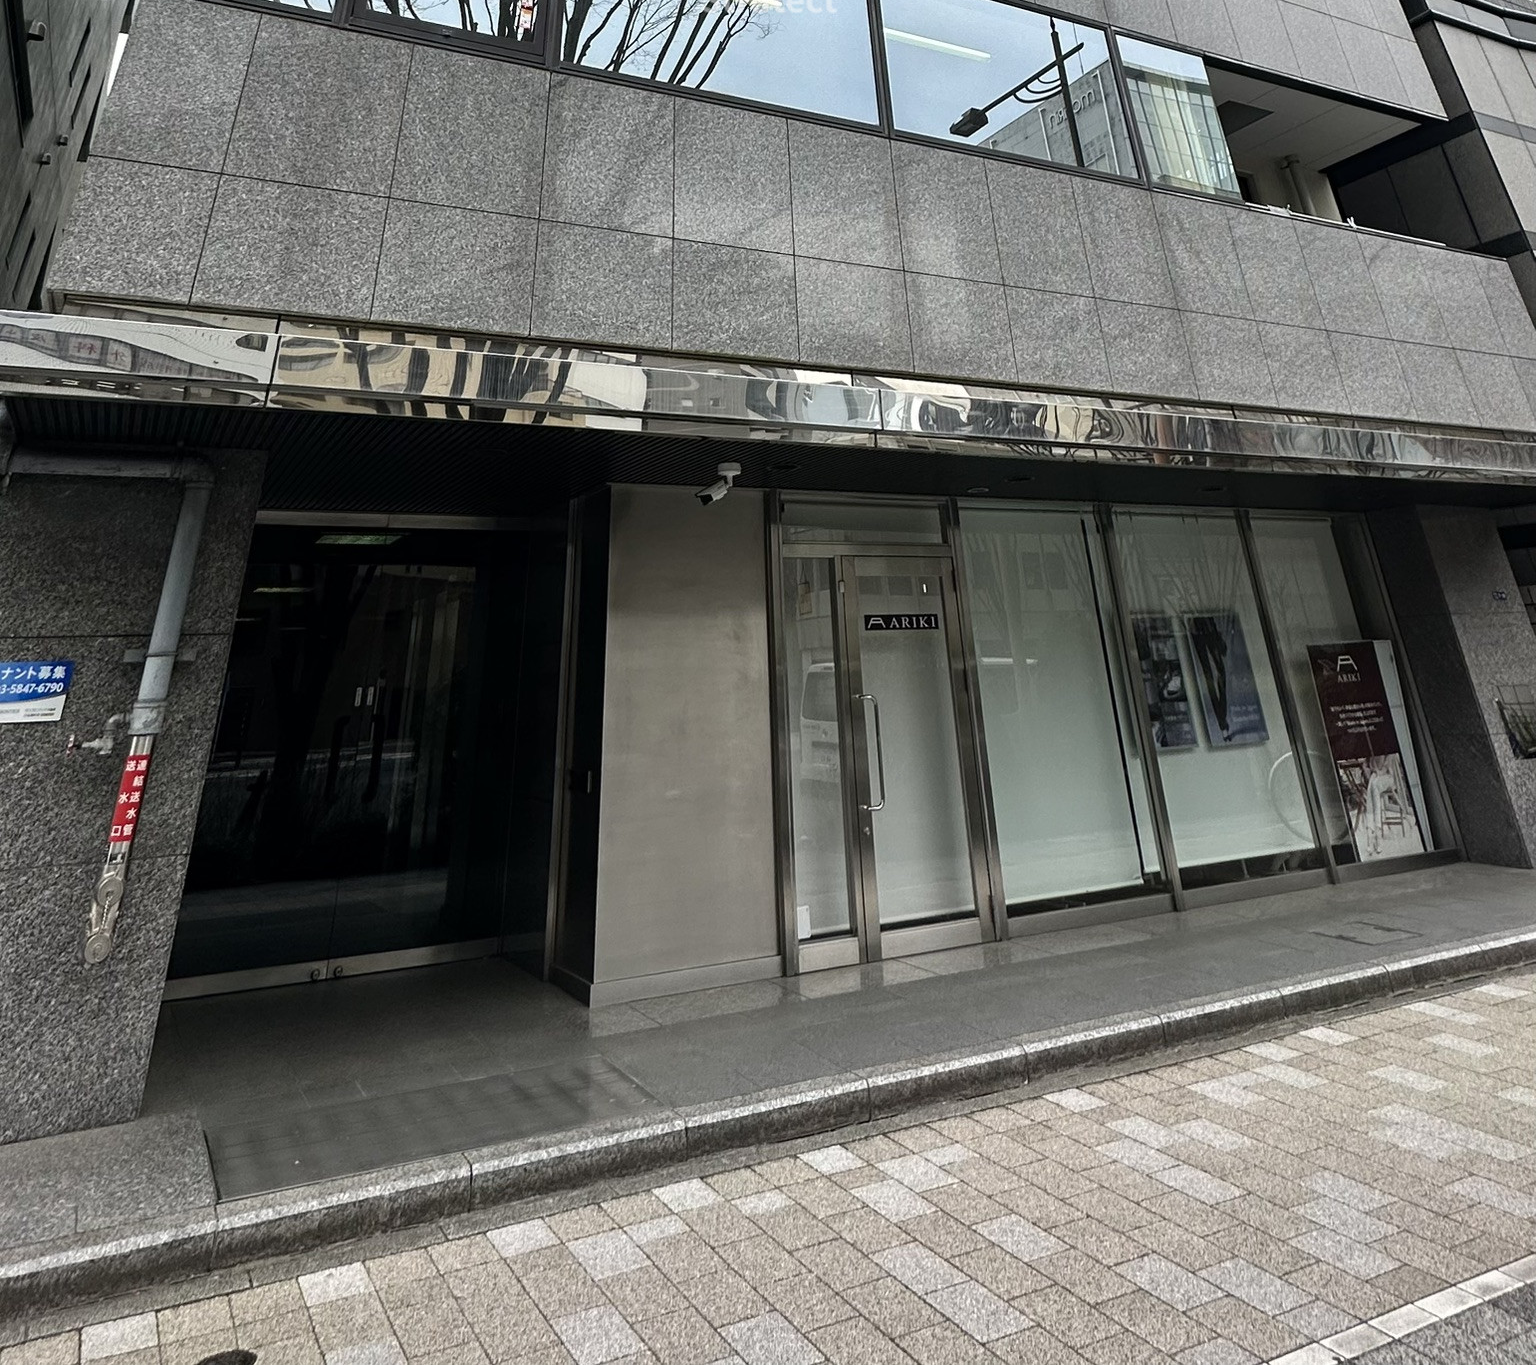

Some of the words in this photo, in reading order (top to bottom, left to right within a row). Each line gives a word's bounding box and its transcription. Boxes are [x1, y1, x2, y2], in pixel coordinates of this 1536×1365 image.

[889, 616, 936, 629] ARIKI
[1, 666, 66, 680] ナント募集
[1337, 672, 1361, 684] ARIKI
[0, 682, 64, 695] 3-5847-6790
[110, 760, 137, 837] 送水口
[122, 759, 148, 836] 連結送水管
